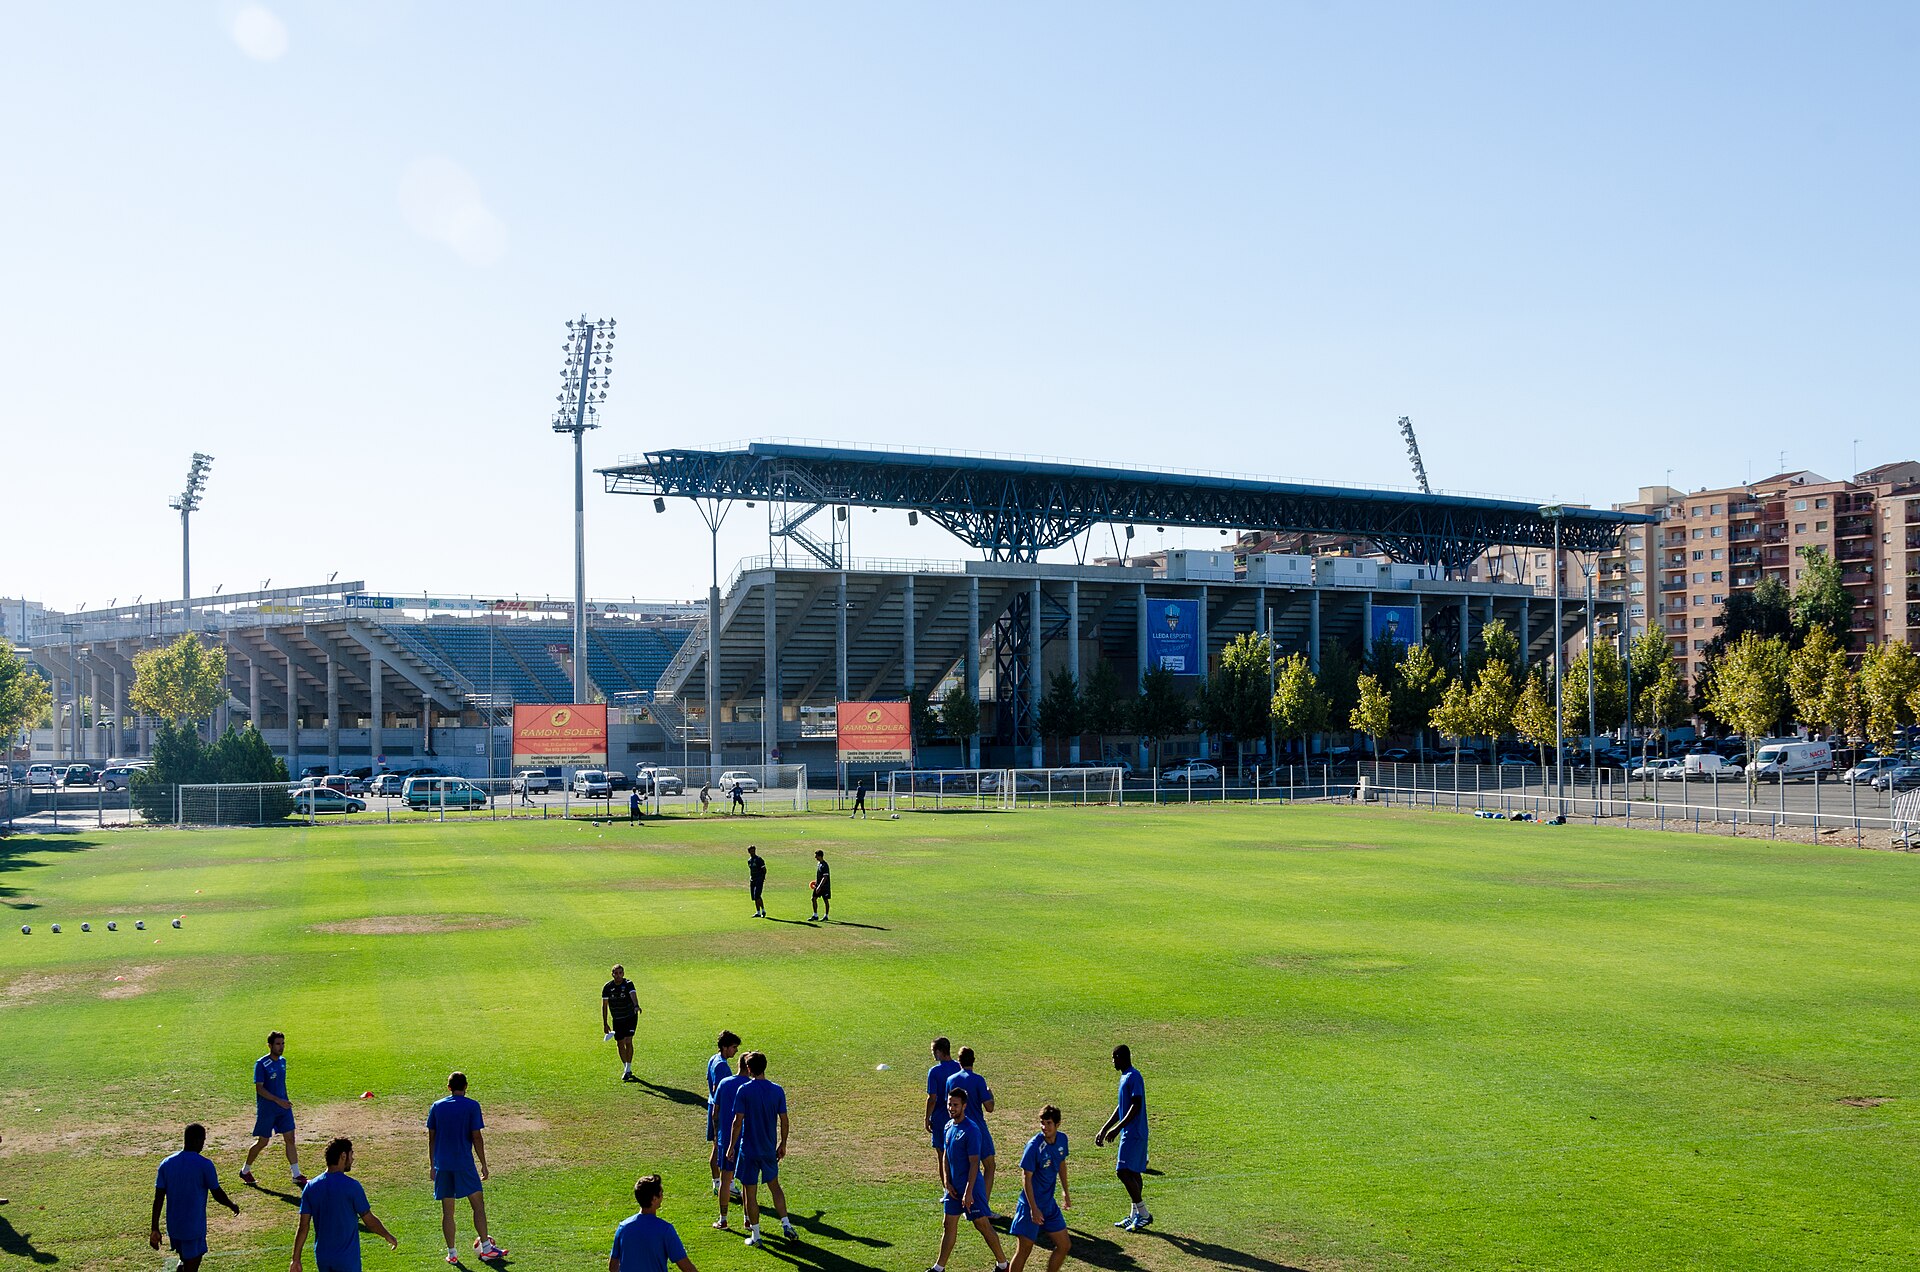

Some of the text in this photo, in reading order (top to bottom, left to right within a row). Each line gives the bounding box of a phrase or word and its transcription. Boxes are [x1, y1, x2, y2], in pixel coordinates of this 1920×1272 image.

[495, 602, 528, 610] DHL
[520, 728, 602, 737] RAMON SOLER
[1809, 749, 1826, 758] NACEX
